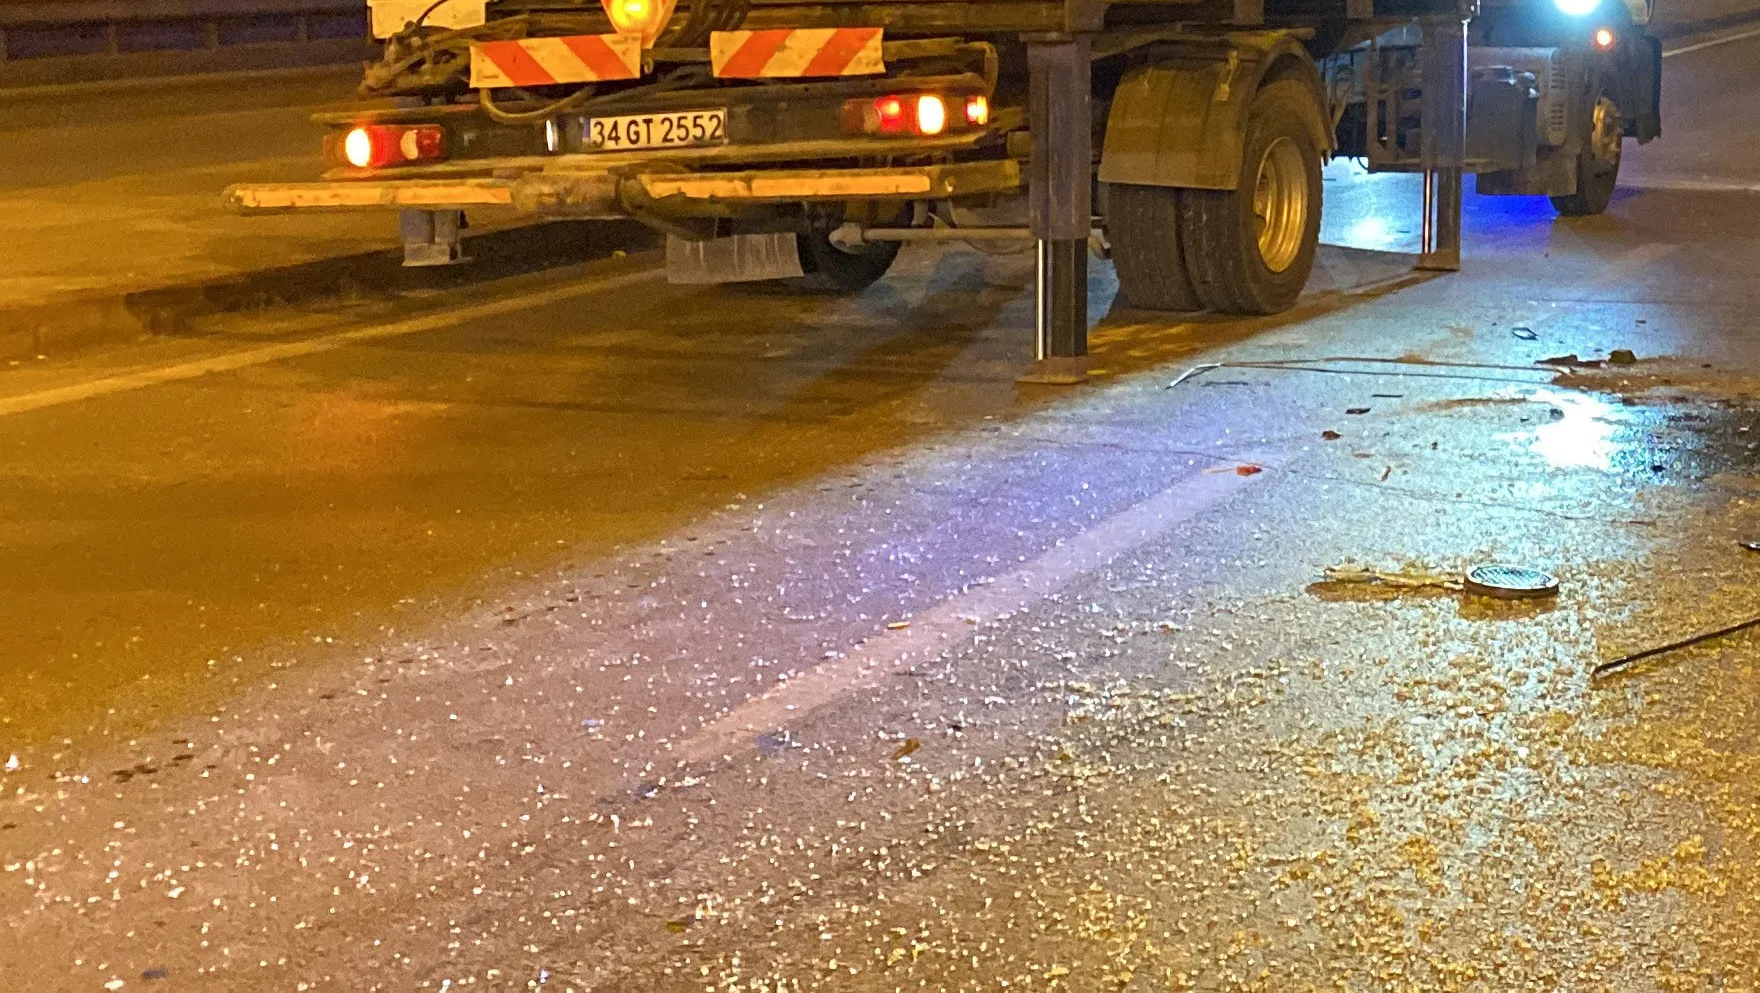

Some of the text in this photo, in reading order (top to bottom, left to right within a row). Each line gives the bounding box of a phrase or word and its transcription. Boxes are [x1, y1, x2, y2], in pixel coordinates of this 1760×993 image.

[593, 114, 723, 149] 34 GT 2552
